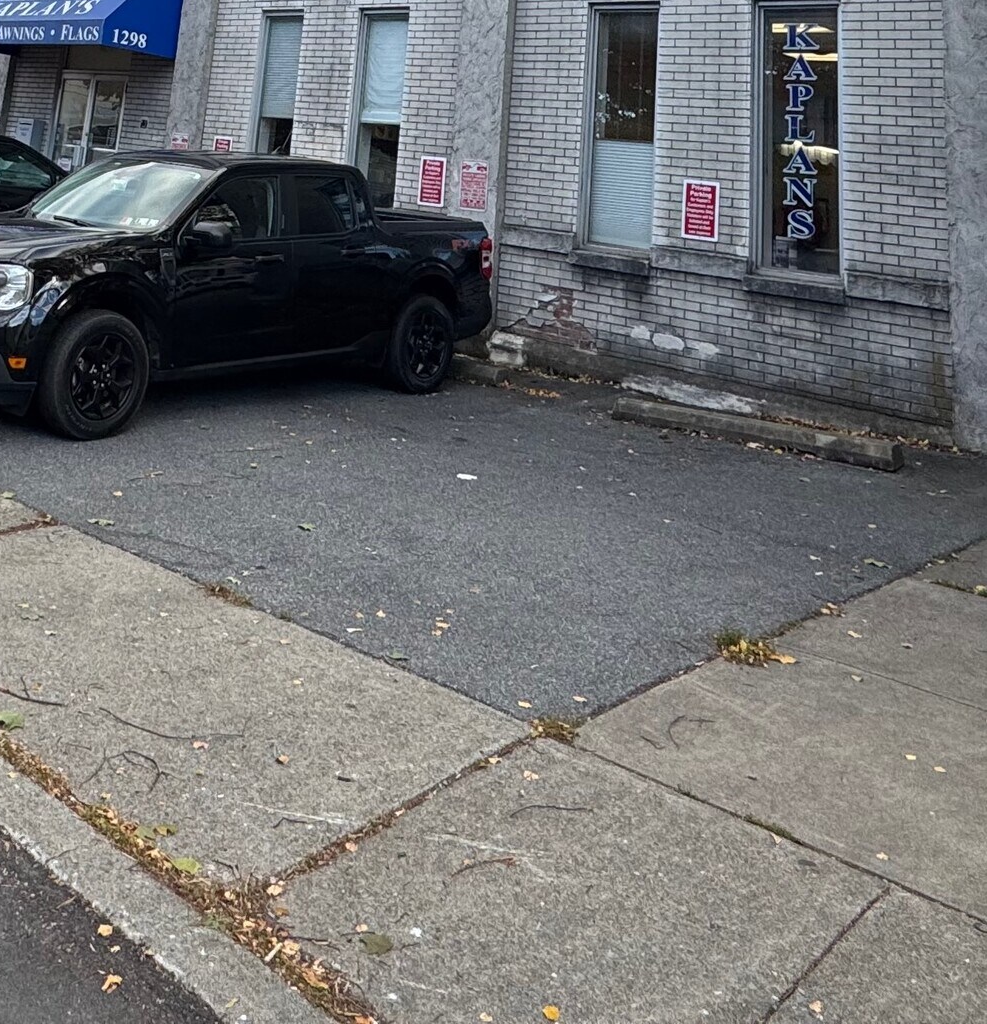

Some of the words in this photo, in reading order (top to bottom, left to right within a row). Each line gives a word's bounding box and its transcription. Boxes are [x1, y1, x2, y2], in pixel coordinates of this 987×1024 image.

[60, 24, 99, 41] FLAGS
[112, 28, 147, 49] 1298
[782, 23, 819, 239] KAPLANS
